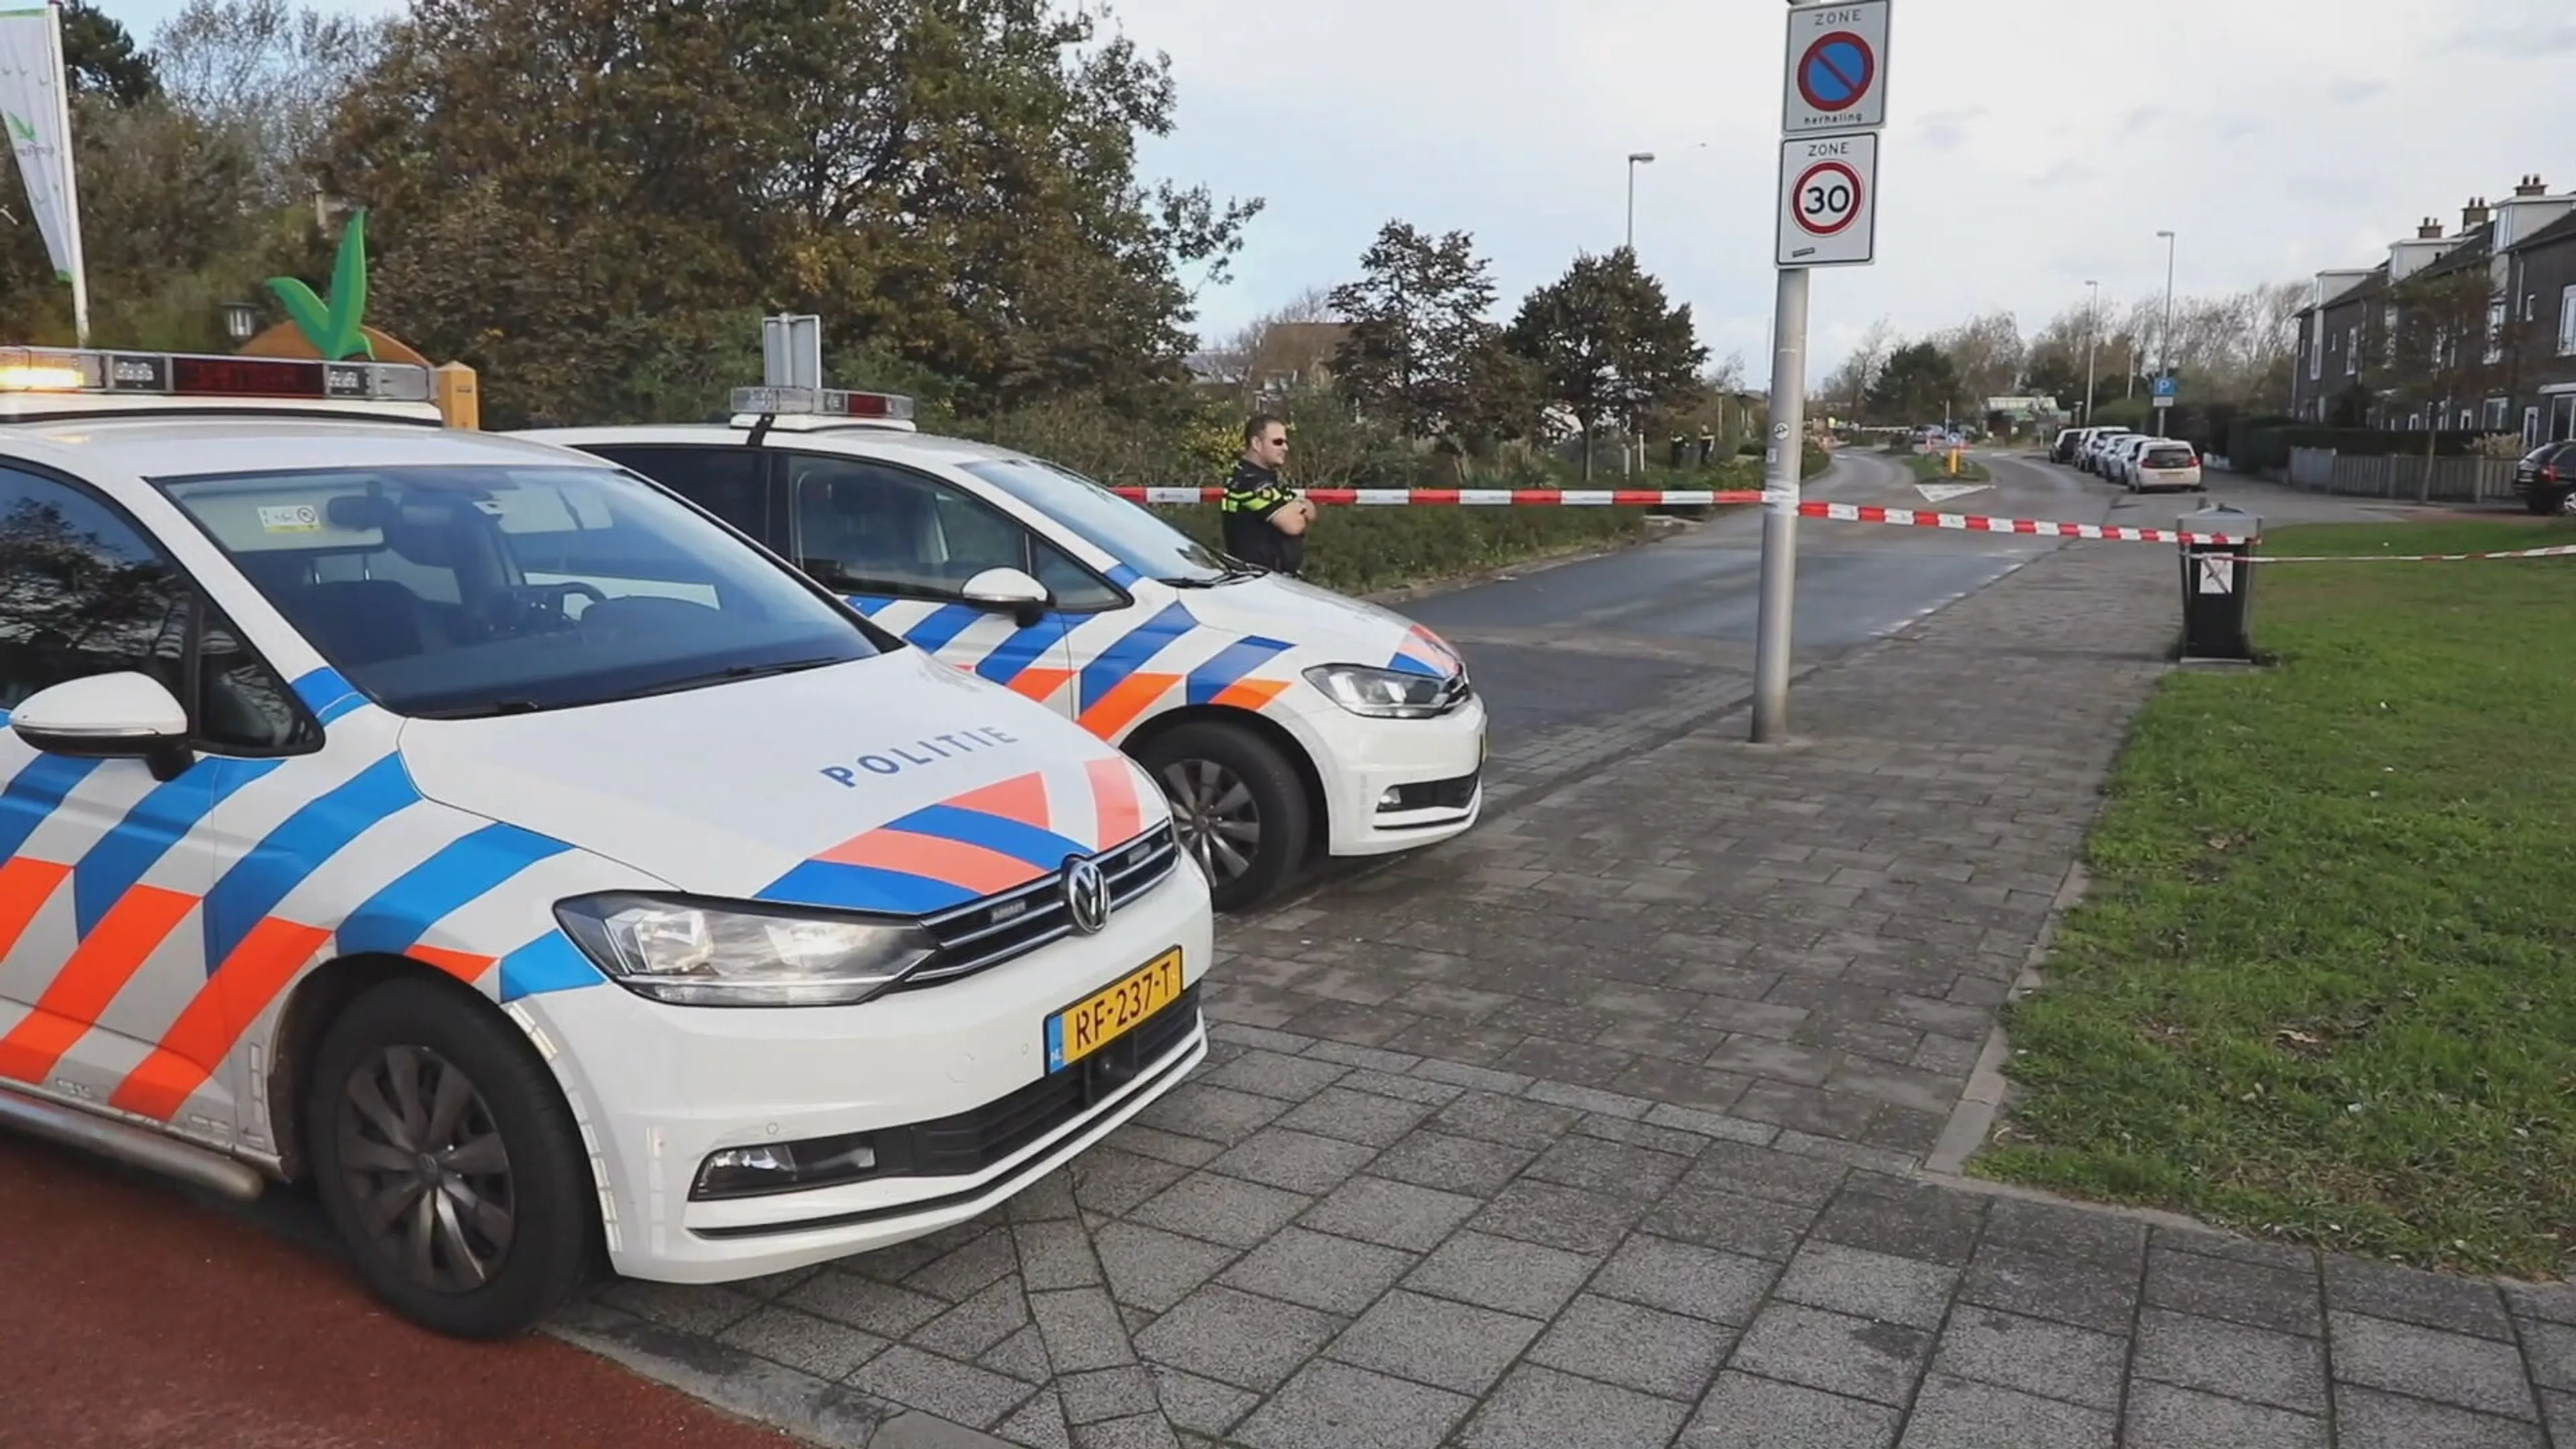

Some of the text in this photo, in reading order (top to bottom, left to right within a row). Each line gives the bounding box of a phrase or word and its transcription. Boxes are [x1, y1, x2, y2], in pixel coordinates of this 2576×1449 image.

[1814, 9, 1861, 25] ZONE
[1805, 113, 1862, 125] herhaling
[1808, 142, 1849, 156] ZONE
[1804, 185, 1849, 214] 30
[2159, 380, 2170, 392] P
[820, 727, 1019, 788] POLITIE
[1076, 961, 1171, 1051] RF-237-T
